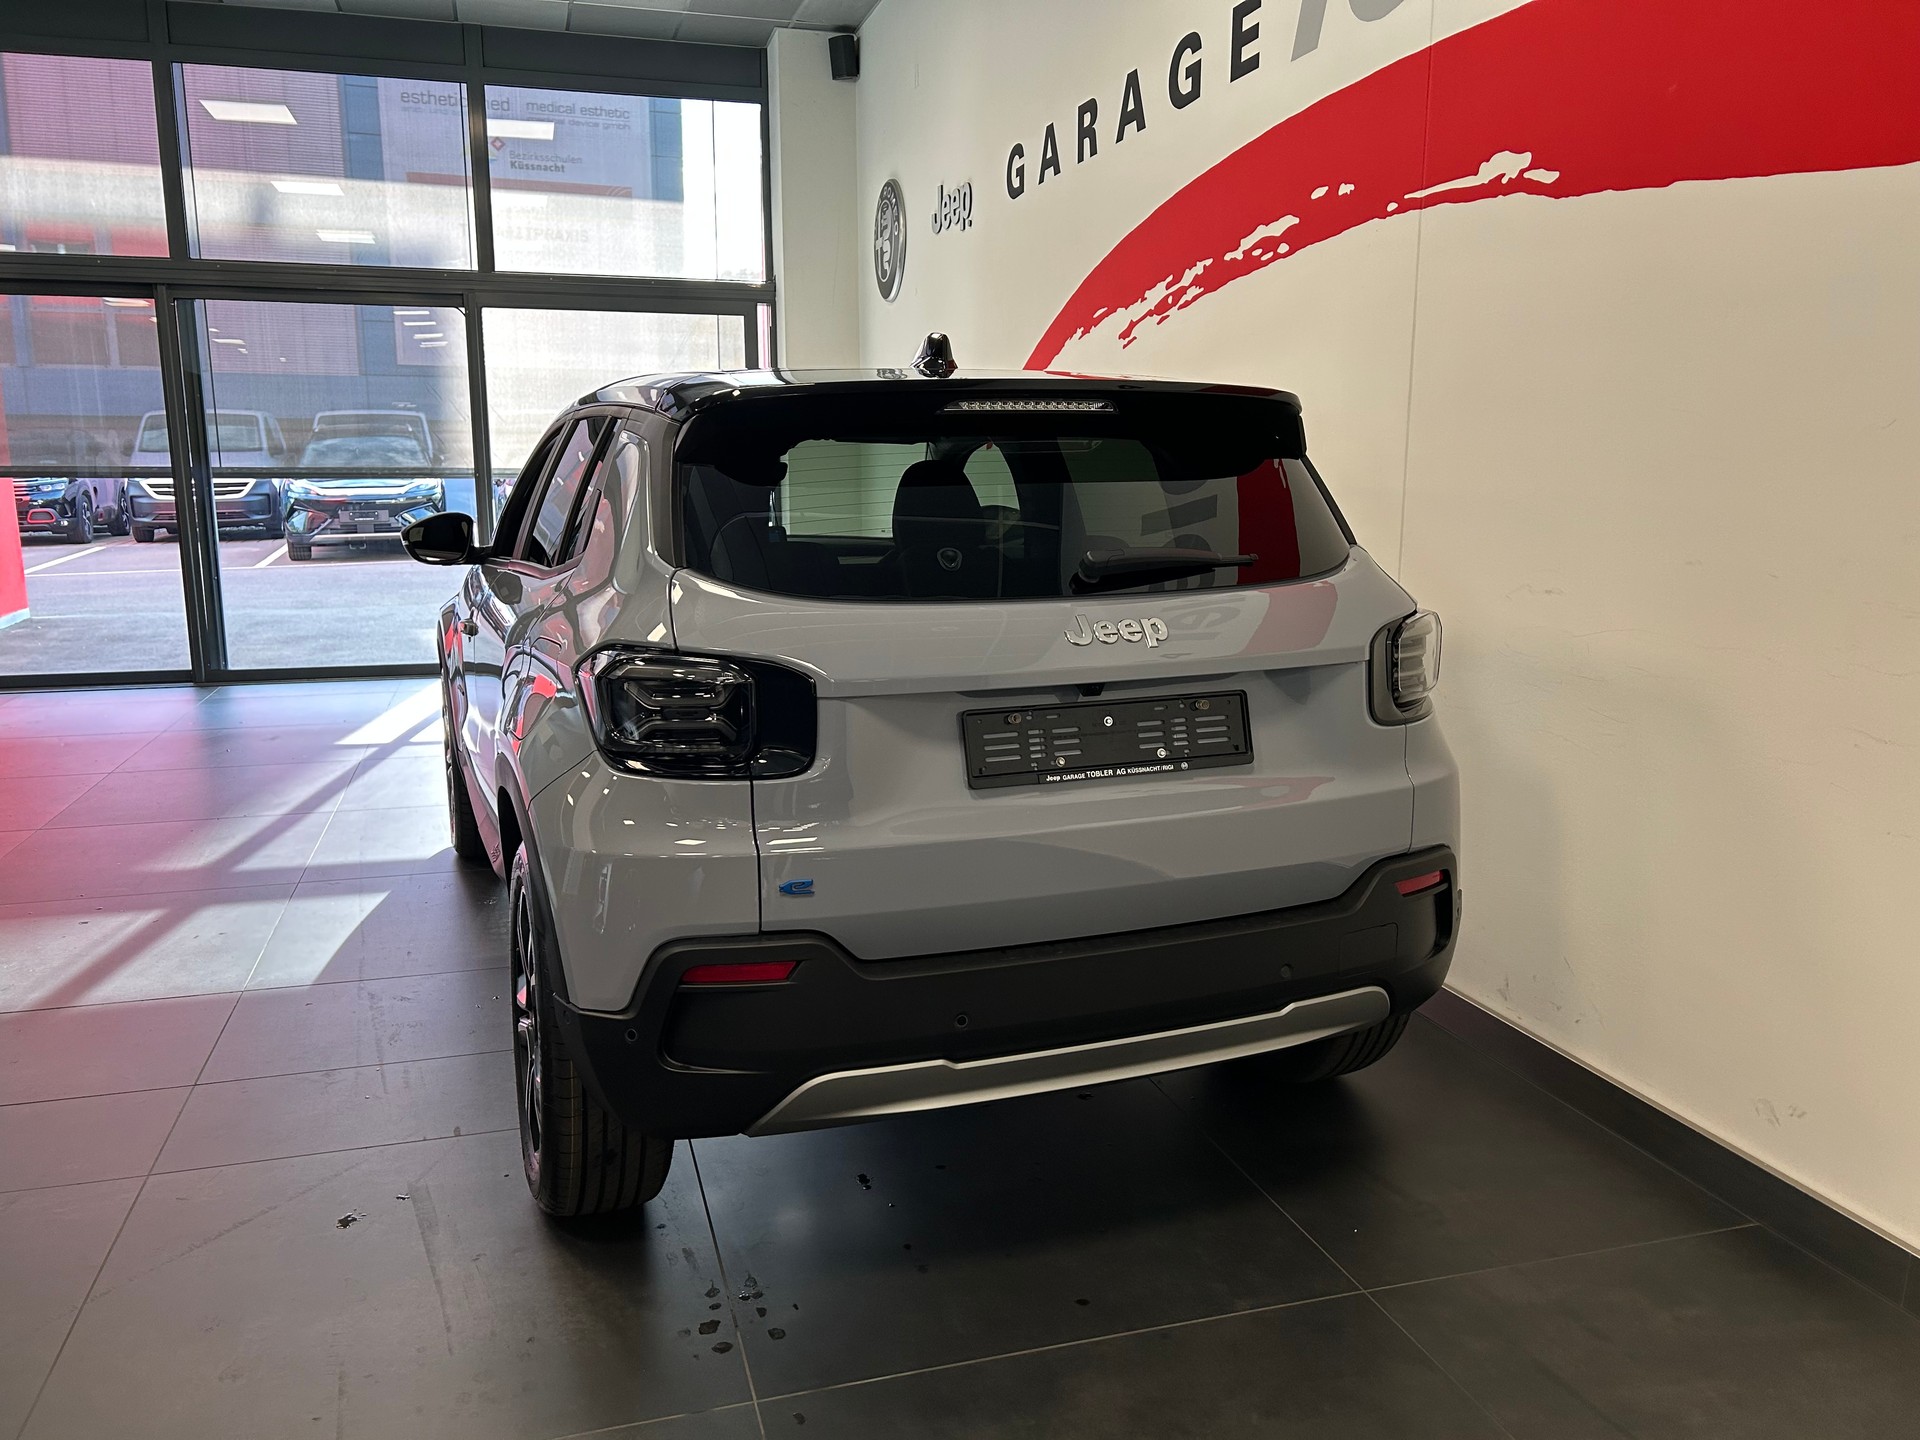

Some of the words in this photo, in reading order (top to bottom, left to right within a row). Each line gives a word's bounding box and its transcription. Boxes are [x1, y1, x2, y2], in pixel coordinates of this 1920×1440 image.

[486, 97, 510, 112] ed
[1006, 0, 1262, 200] GARAGE
[526, 101, 576, 115] medical
[580, 105, 630, 119] esthetic
[509, 150, 583, 164] Bezirksschulen
[510, 160, 565, 173] Küssnacht
[931, 181, 973, 234] Jeep
[1064, 614, 1169, 648] Jeep
[1045, 774, 1061, 782] Jeep
[1062, 772, 1086, 781] GARAGE
[1086, 769, 1114, 778] TOBLER
[1116, 767, 1127, 776] AG
